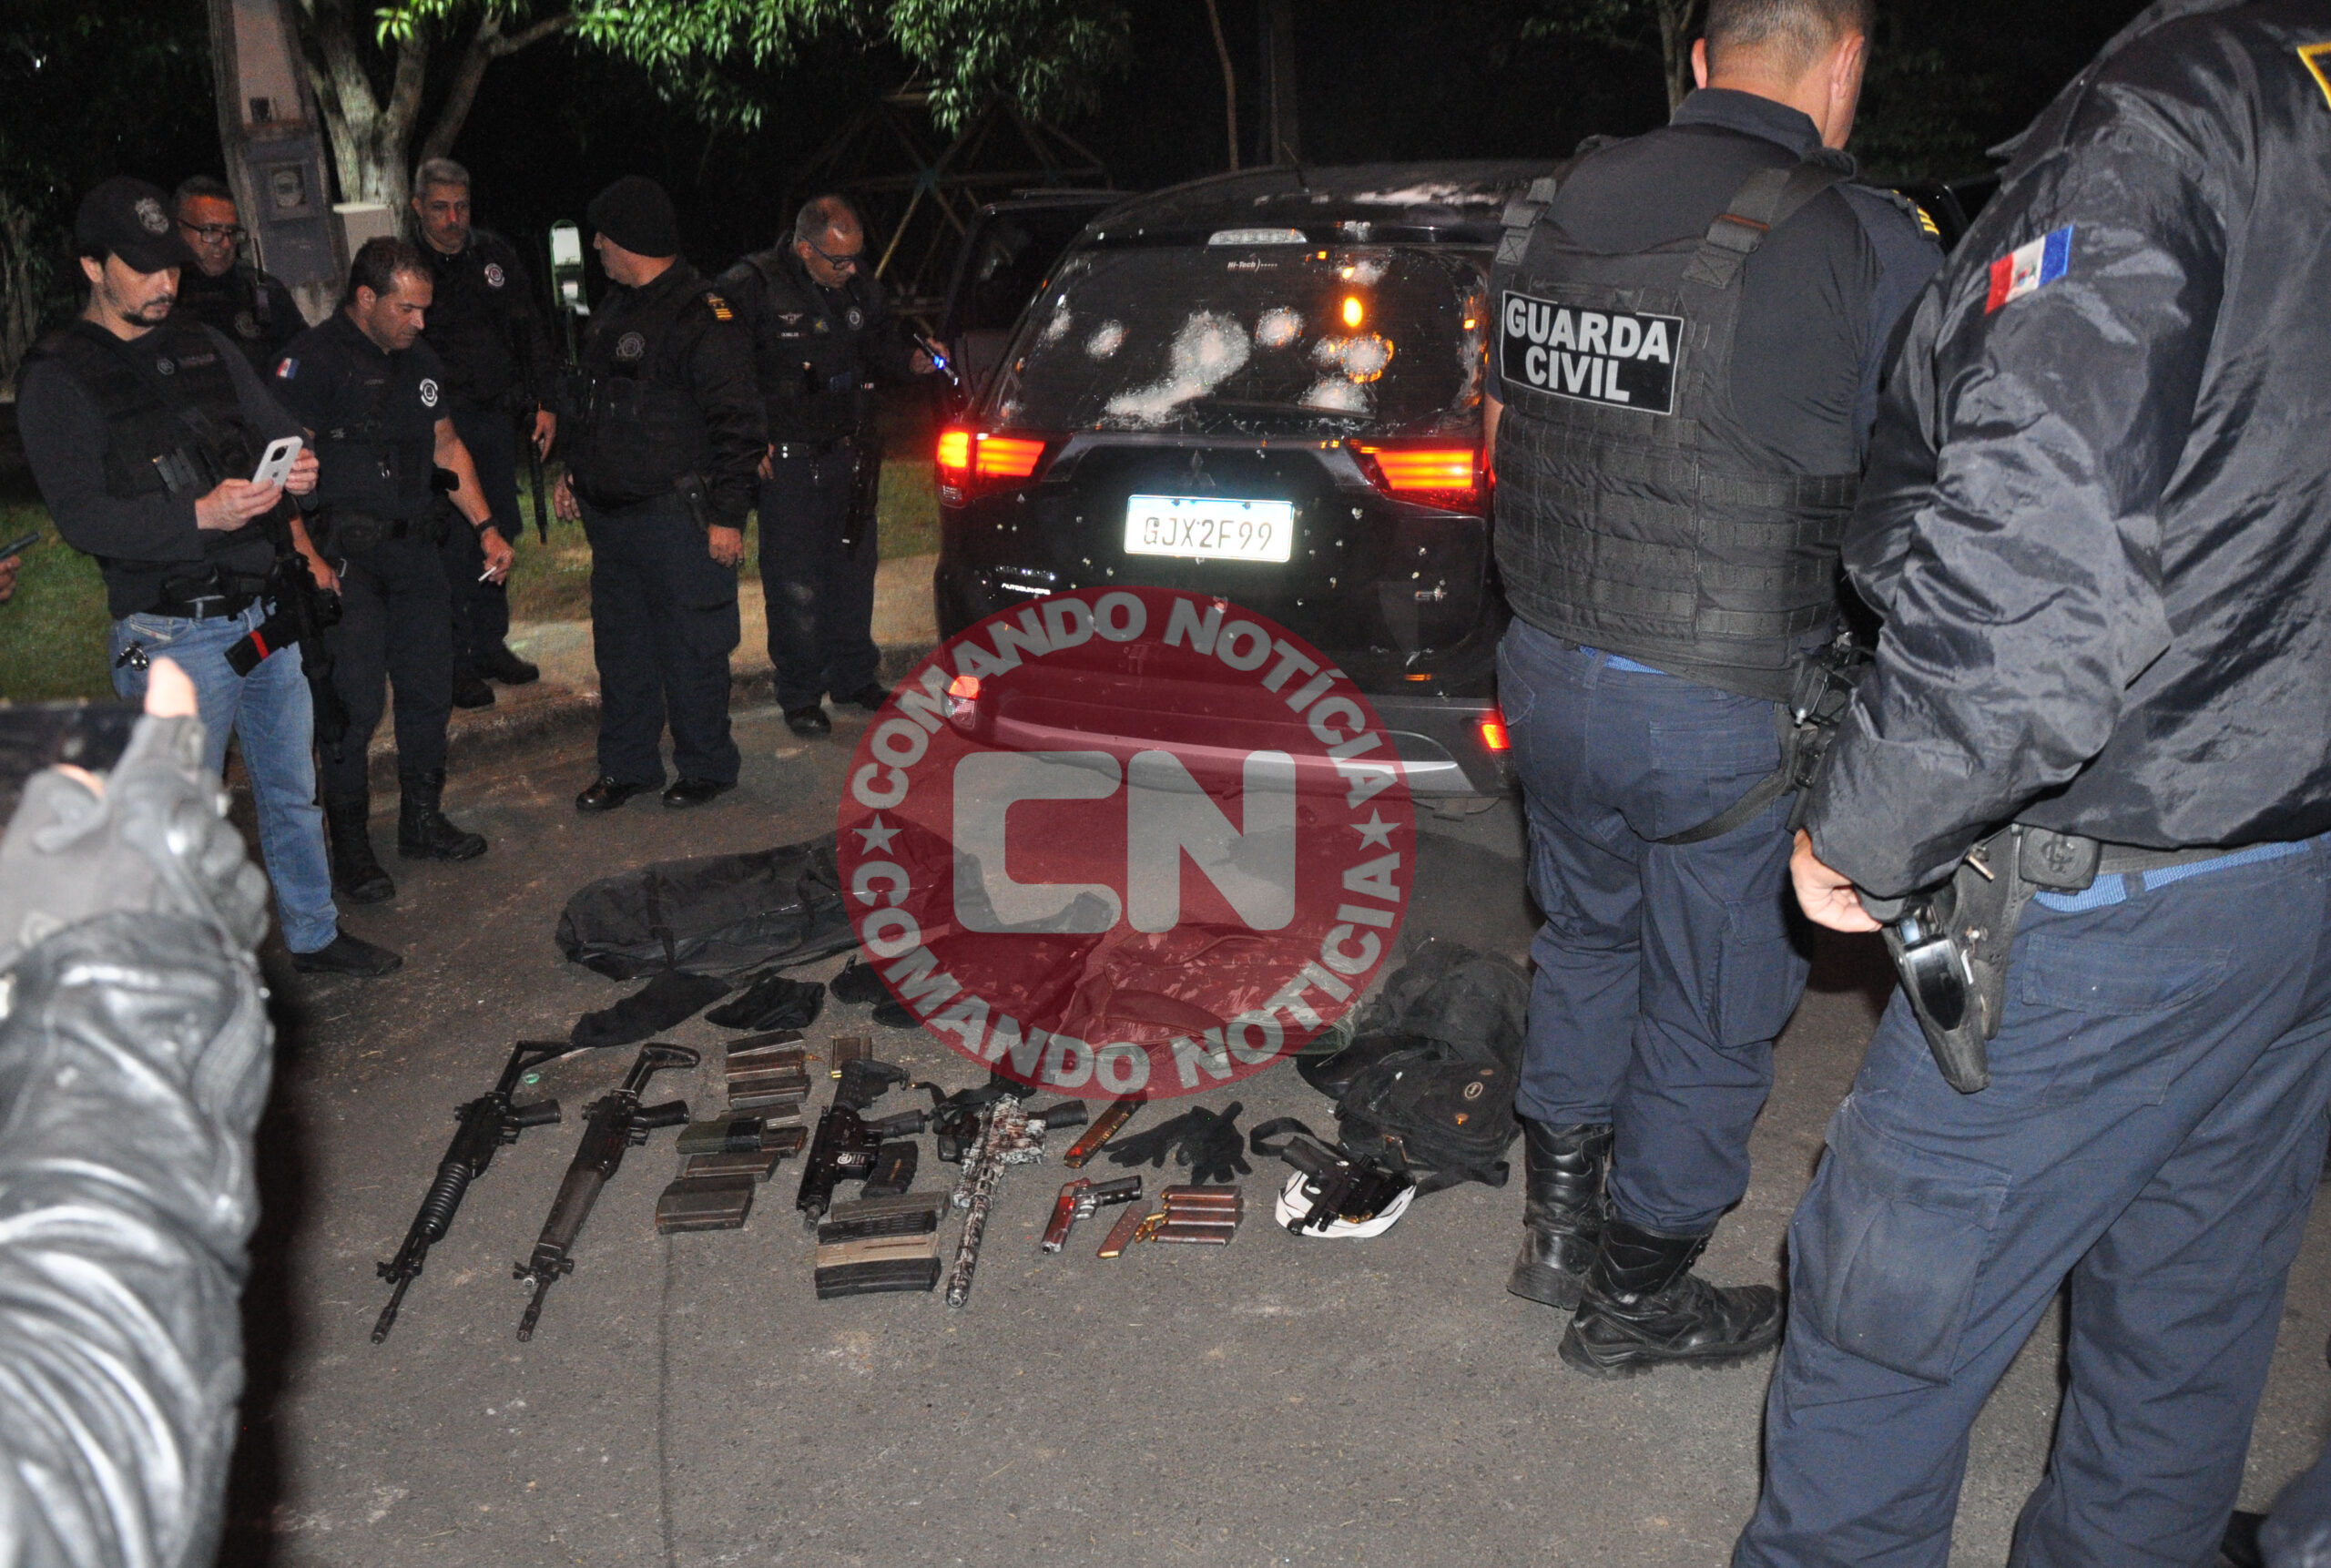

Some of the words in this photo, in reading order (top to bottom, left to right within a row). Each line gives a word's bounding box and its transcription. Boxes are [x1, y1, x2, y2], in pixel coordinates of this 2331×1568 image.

[1506, 298, 1670, 363] GUARDA
[1525, 345, 1630, 402] CIVIL
[1144, 516, 1272, 551] GJX2F99
